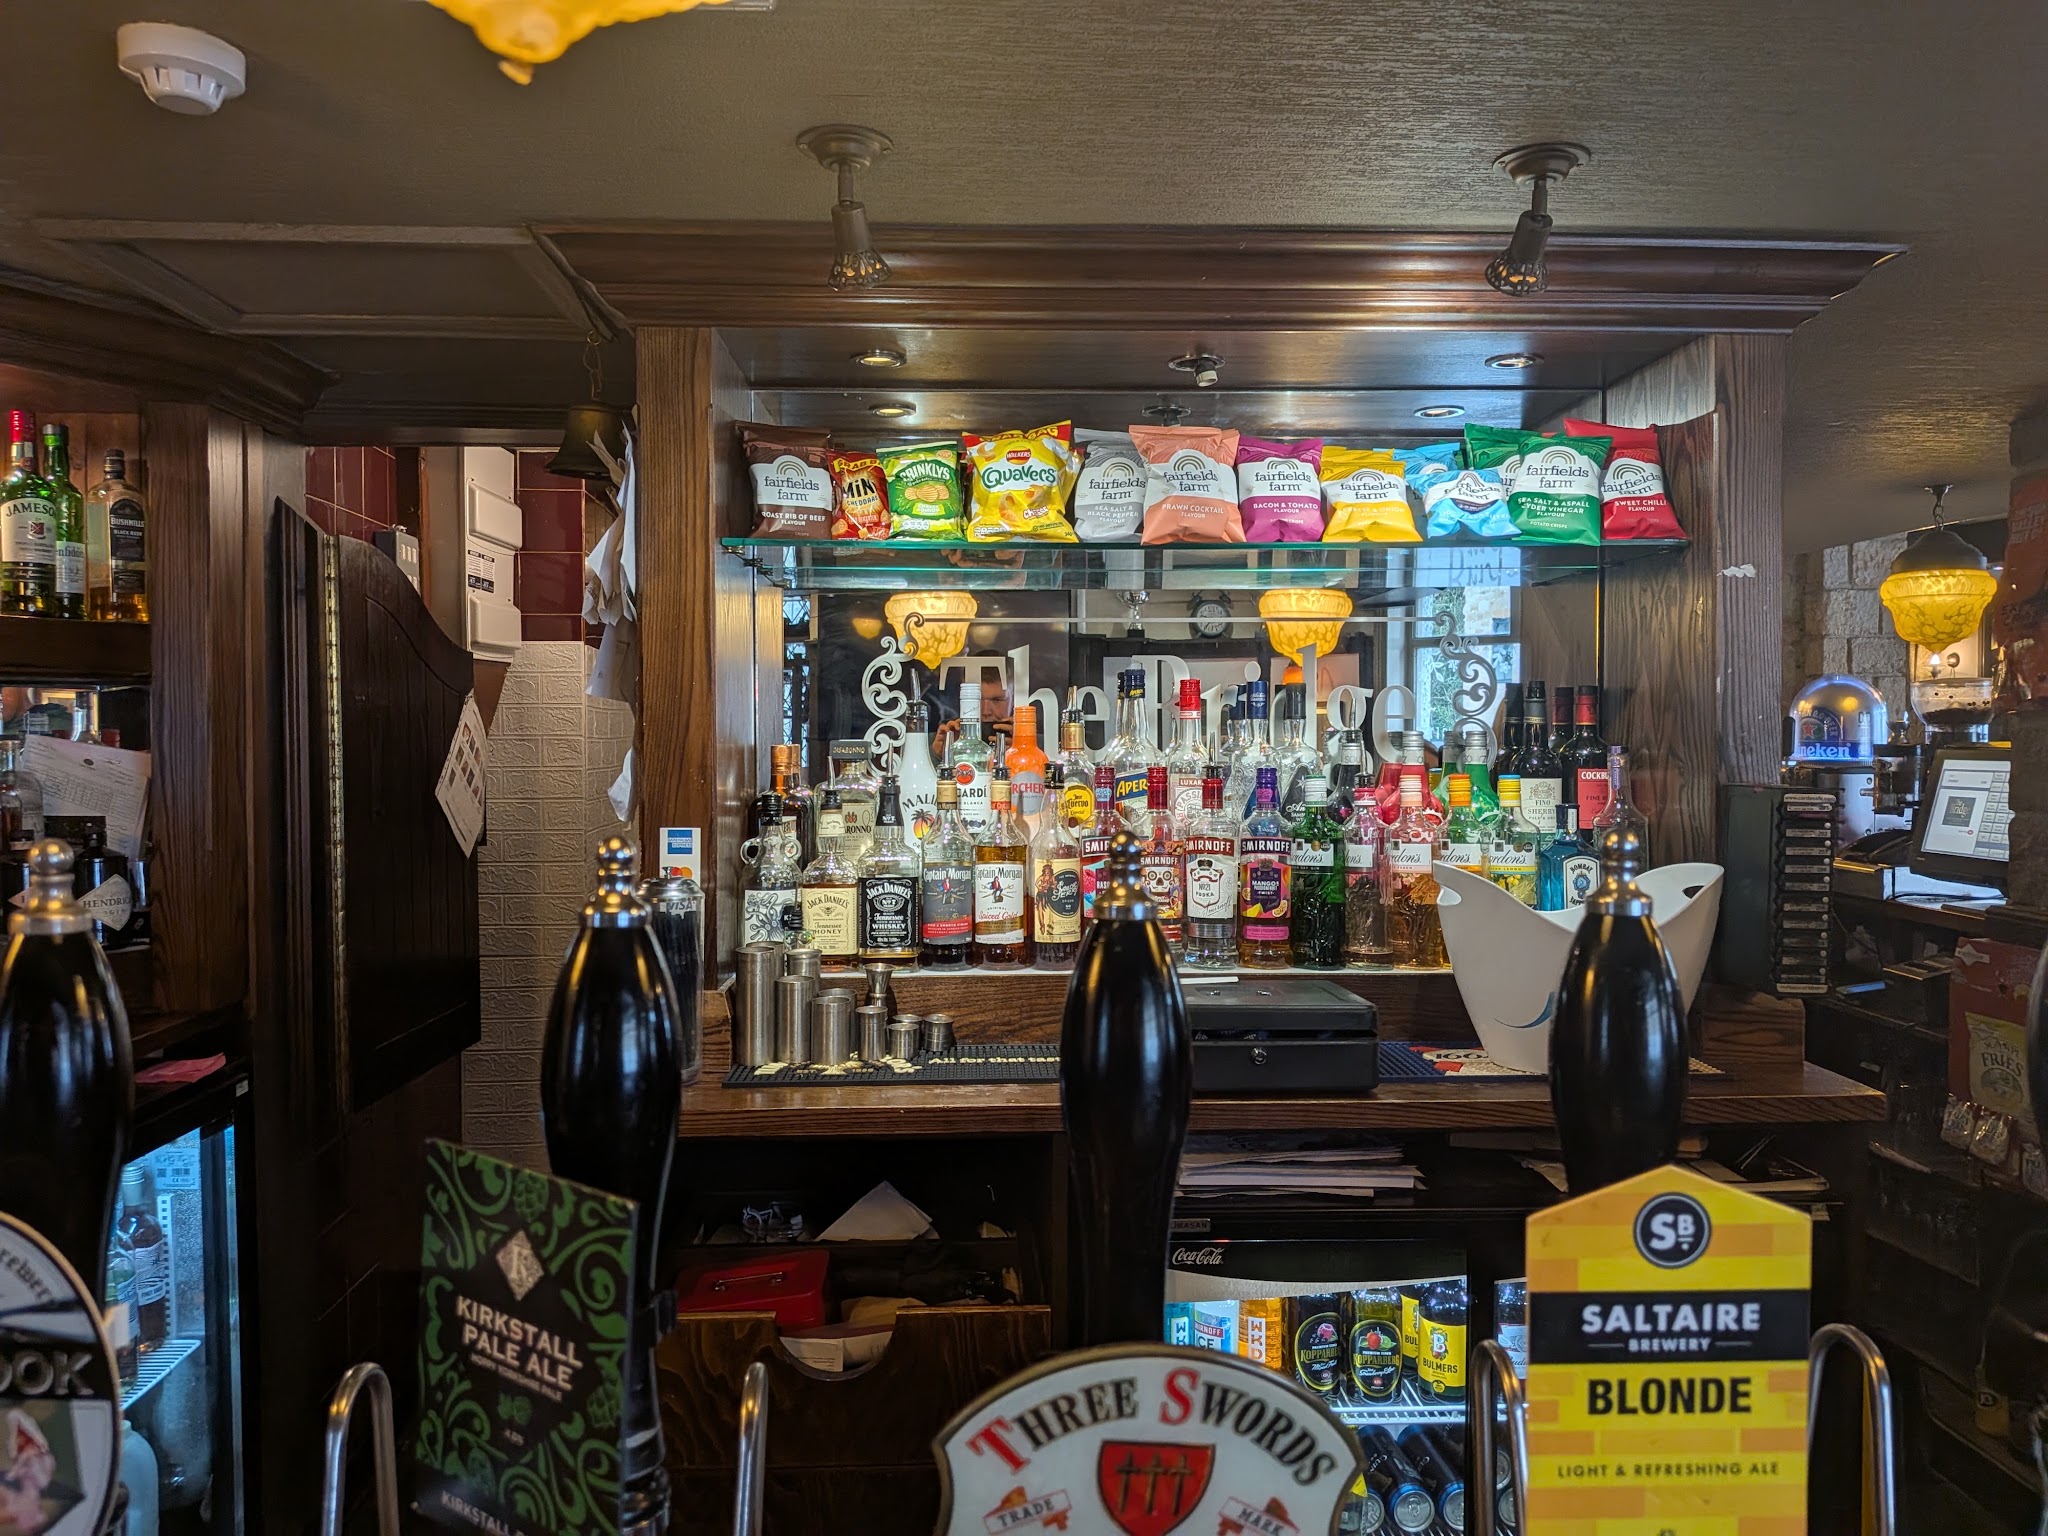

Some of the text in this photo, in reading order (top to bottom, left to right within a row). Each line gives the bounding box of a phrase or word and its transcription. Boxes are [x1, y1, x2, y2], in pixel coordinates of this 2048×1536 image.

[1006, 449, 1031, 458] WALKERS
[901, 462, 950, 481] CRINKLYS
[1163, 470, 1218, 482] fairfields
[1255, 472, 1311, 482] fairfields
[1526, 465, 1589, 478] fairfields
[764, 476, 820, 491] fairfields
[1089, 477, 1146, 490] fairfields
[1179, 482, 1209, 492] farm
[1269, 481, 1301, 492] farm
[1340, 481, 1399, 491] fairfields
[1539, 477, 1573, 488] farm
[1602, 472, 1662, 493] fairfields
[778, 489, 808, 501] farm
[1101, 490, 1132, 500] farm
[1355, 491, 1388, 500] farm
[6, 502, 55, 517] JAMESO
[761, 511, 783, 519] ROAST
[1190, 504, 1224, 514] COCKTAIL
[1548, 506, 1584, 514] VINEGAR
[110, 517, 145, 527] BUSHMILLS
[939, 644, 1415, 793] The Bridge
[1799, 743, 1851, 758] neken
[1581, 771, 1610, 779] COCKBU
[957, 785, 987, 798] CARDÍ
[1011, 782, 1044, 794] RCHER
[1116, 778, 1148, 797] APER
[902, 793, 938, 812] MALI
[1176, 790, 1201, 808] PASSI
[845, 826, 871, 834] RONNO
[1085, 841, 1110, 853] SMIR
[1186, 840, 1232, 852] SMIRNOFF
[1242, 840, 1290, 852] SMIRNOFF
[1141, 856, 1178, 865] SMIRNOFF
[1293, 849, 1323, 864] rdon's
[1391, 849, 1421, 864] rdon's
[1440, 849, 1471, 864] rdon's
[1490, 849, 1527, 865] ordon's
[923, 867, 971, 882] Captain Morgan
[996, 867, 1022, 880] Morgan
[1569, 863, 1593, 875] BOMBAY
[866, 882, 912, 900] JACK DANIEL'S
[807, 893, 850, 909] JACK DANIEL'S
[874, 913, 904, 921] Tennessee
[979, 911, 1019, 921] Spiced Gold
[1981, 1052, 2023, 1077] FRIES
[1581, 1302, 1761, 1334] SALTAIRE
[455, 1295, 583, 1368] KIRKSTALL
[1176, 1321, 1187, 1346] WK
[1251, 1320, 1263, 1360] WKD
[1628, 1338, 1711, 1353] BREWERY
[462, 1327, 574, 1391] PALE ALE
[1300, 1347, 1339, 1361] KOPPARBE
[1353, 1353, 1399, 1366] KOPPARBERG
[1422, 1357, 1458, 1374] BULMERS
[1587, 1377, 1752, 1416] BLONDE
[966, 1366, 1339, 1487] THREE SWORDS
[1557, 1461, 1779, 1479] LIGHT & REFRESHING ALE
[997, 1498, 1286, 1536] TRADE MARK
